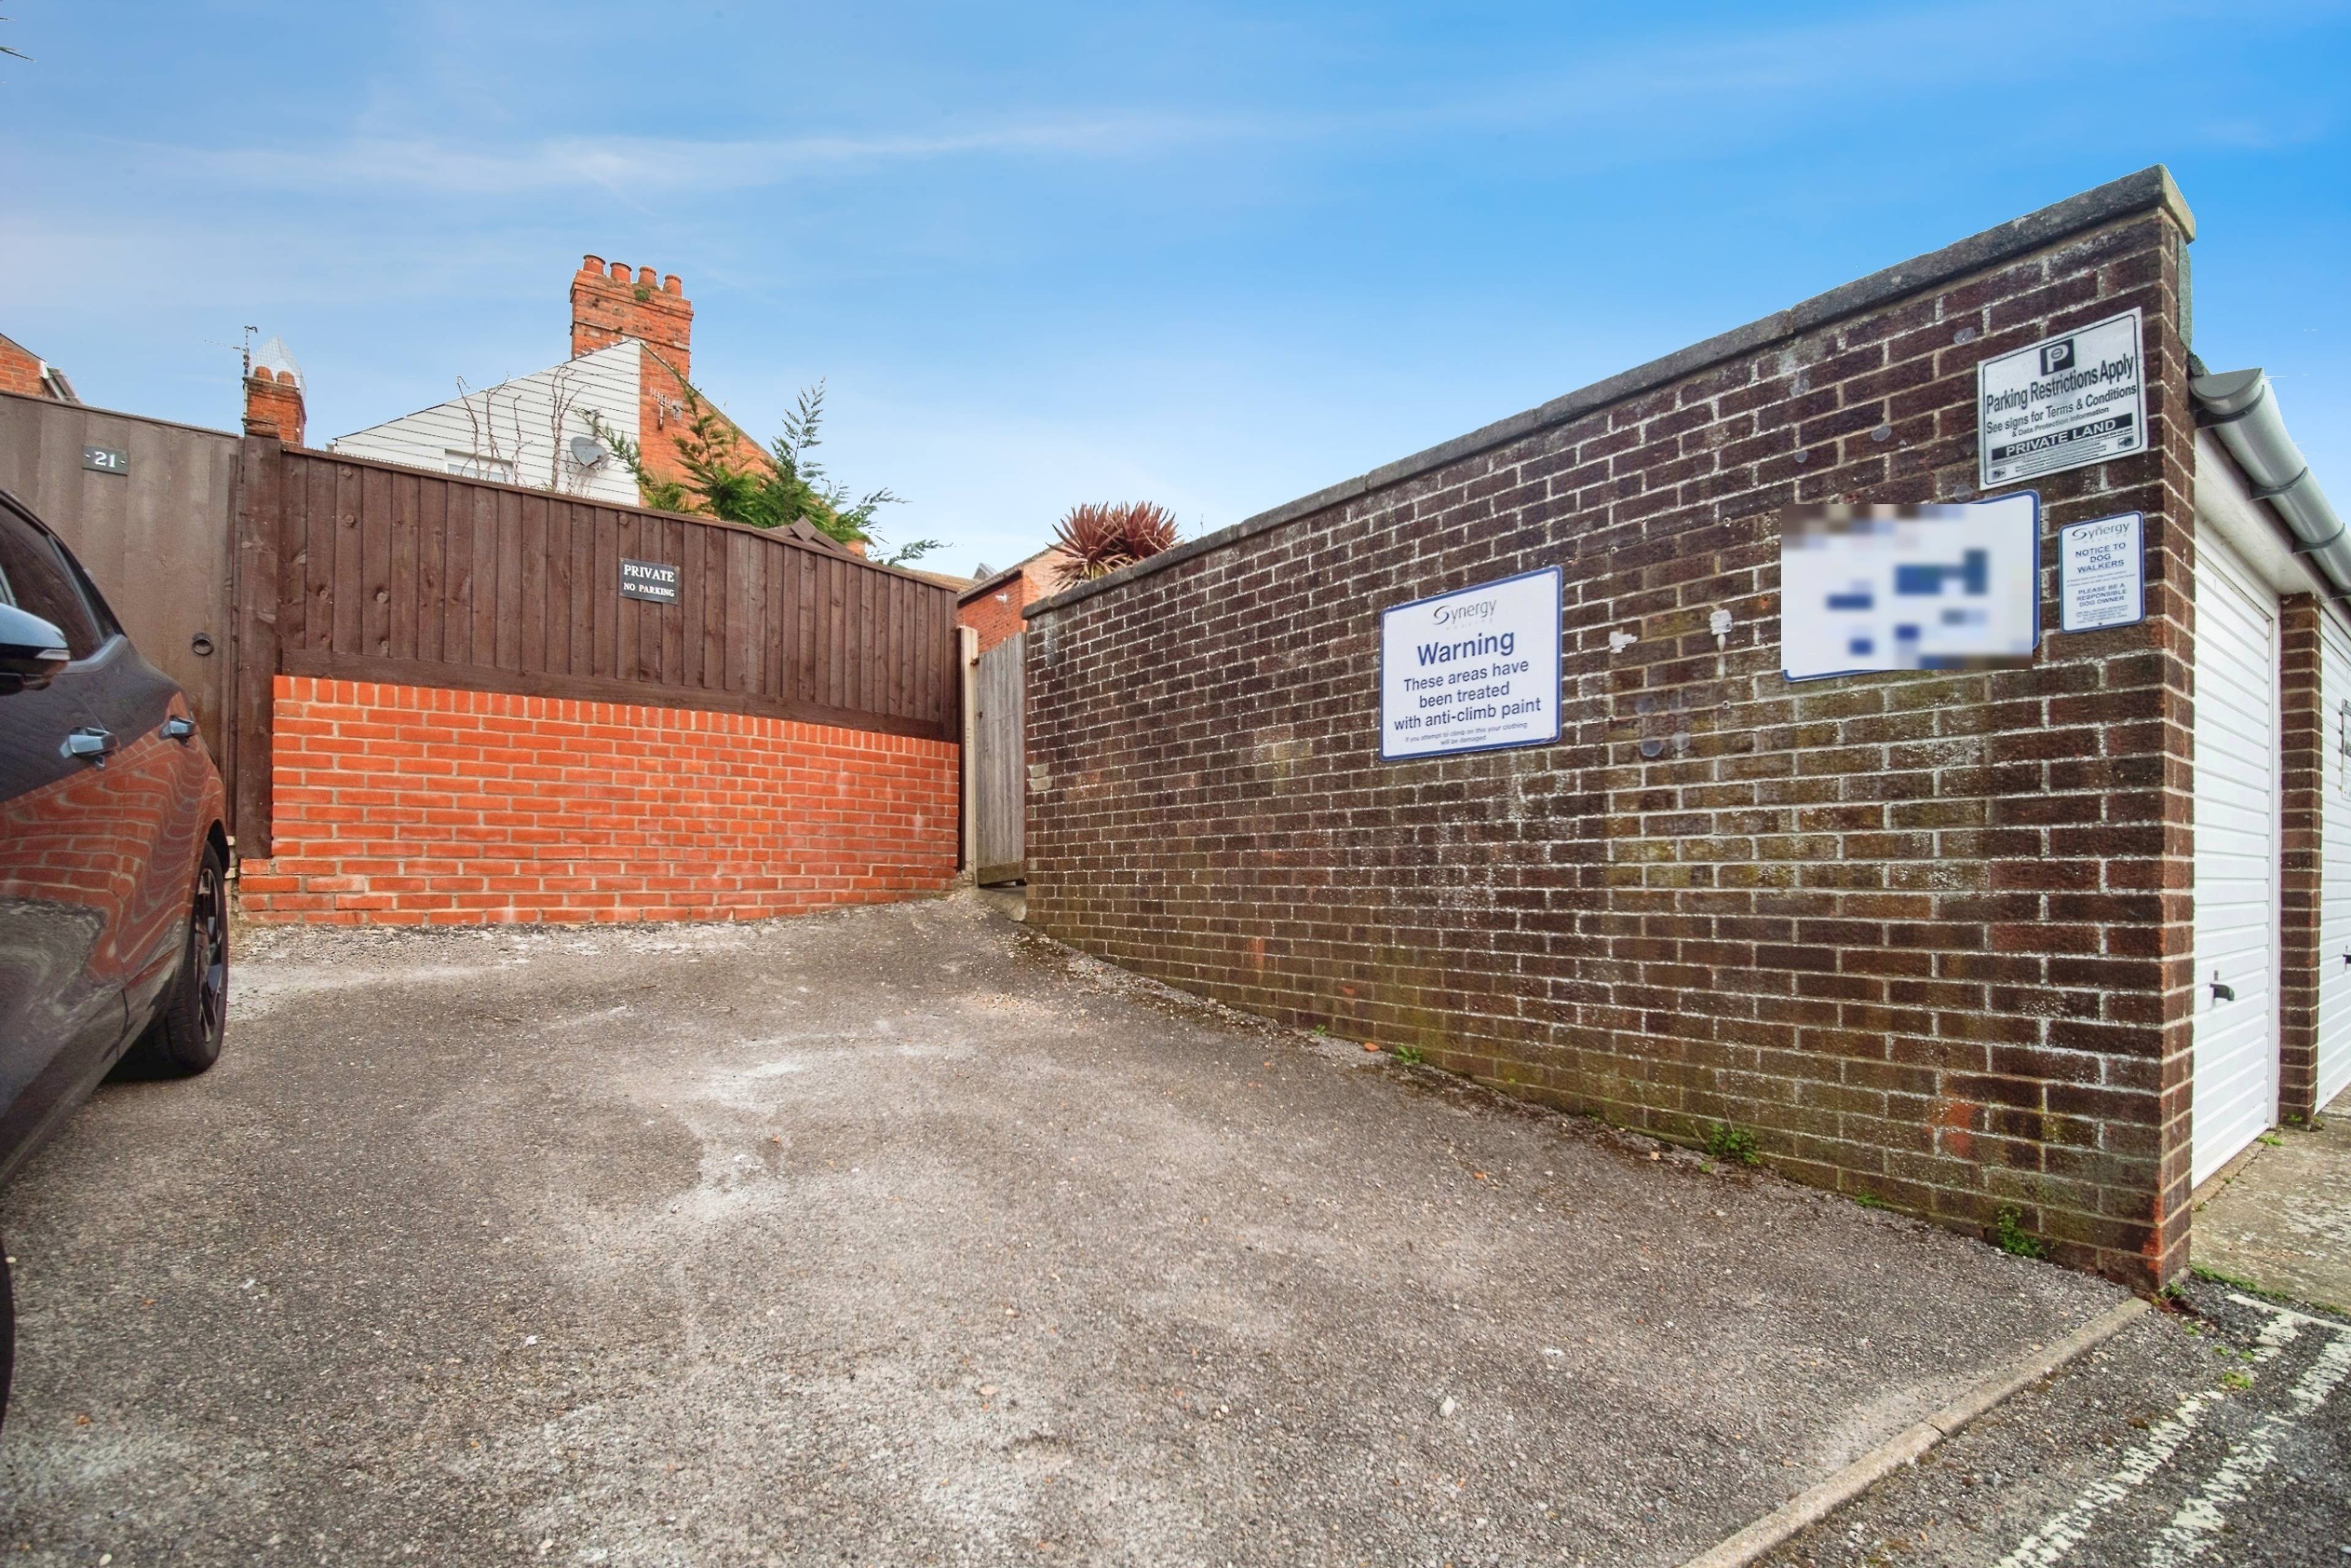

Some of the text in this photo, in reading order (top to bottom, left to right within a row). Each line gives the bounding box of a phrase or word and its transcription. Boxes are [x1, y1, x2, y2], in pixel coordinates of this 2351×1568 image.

[1986, 353, 2134, 415] Parking Restrictions Apply
[1986, 384, 2137, 435] See signs for Terms & Conditions
[2034, 418, 2069, 431] Protection
[2070, 407, 2109, 422] Information
[2006, 431, 2068, 457] PRIVATE
[2072, 419, 2117, 440] LAND
[94, 451, 116, 468] 21
[2071, 522, 2130, 541] Synergy
[2075, 544, 2110, 558] NOTICE
[2090, 553, 2112, 563] DOG
[623, 563, 675, 583] PRIVATE
[2077, 559, 2124, 574] WALKERS
[623, 582, 675, 598] NO PARKING
[2076, 588, 2127, 601] RESPONSIBLE
[2078, 585, 2107, 595] PLEASE
[2096, 595, 2124, 604] OWNER
[1433, 599, 1498, 625] Synergy
[1417, 631, 1515, 667] Warning
[1403, 659, 1529, 692] These areas have
[1419, 681, 1510, 709] been treated
[1393, 697, 1542, 731] with anti-climb paint
[1502, 722, 1528, 730] clothing
